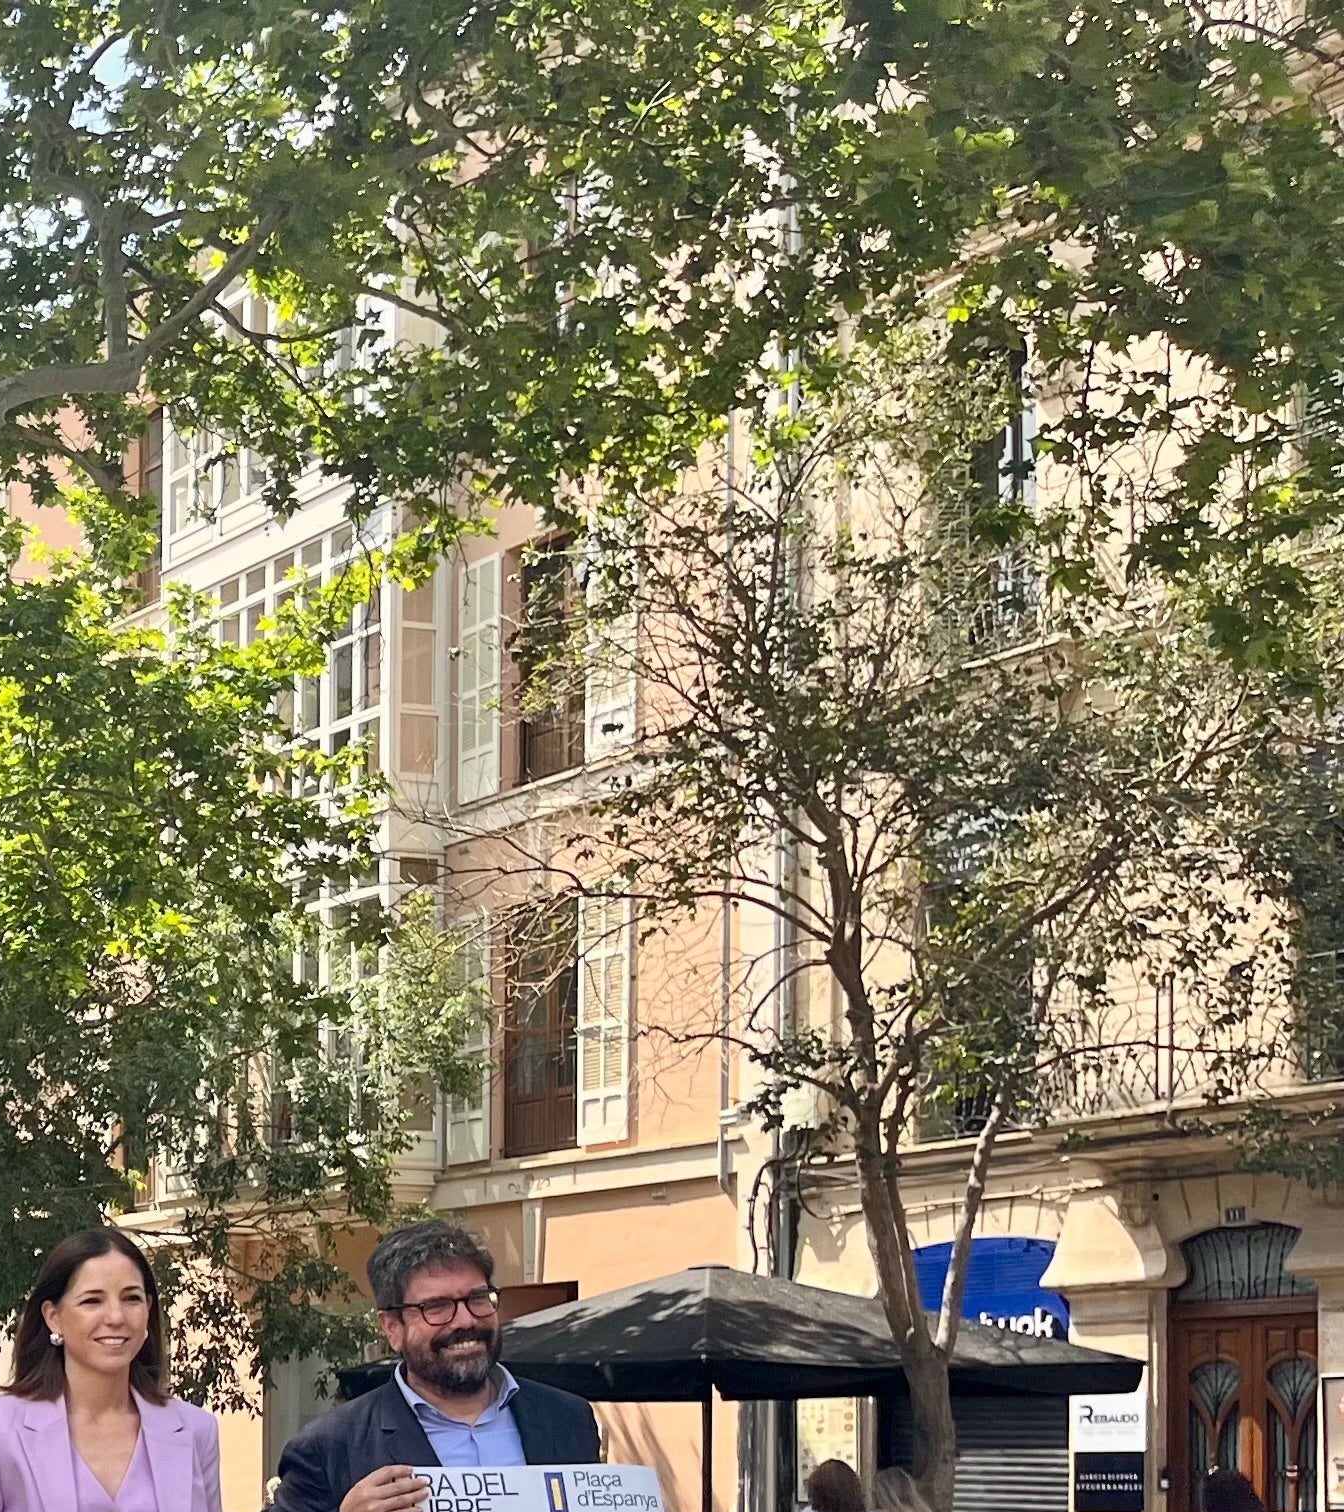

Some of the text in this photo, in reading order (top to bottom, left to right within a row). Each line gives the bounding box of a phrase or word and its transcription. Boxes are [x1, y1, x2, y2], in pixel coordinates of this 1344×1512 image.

[462, 1472, 519, 1497] DEL
[573, 1471, 622, 1491] Plaça
[577, 1489, 658, 1511] d'Espanya
